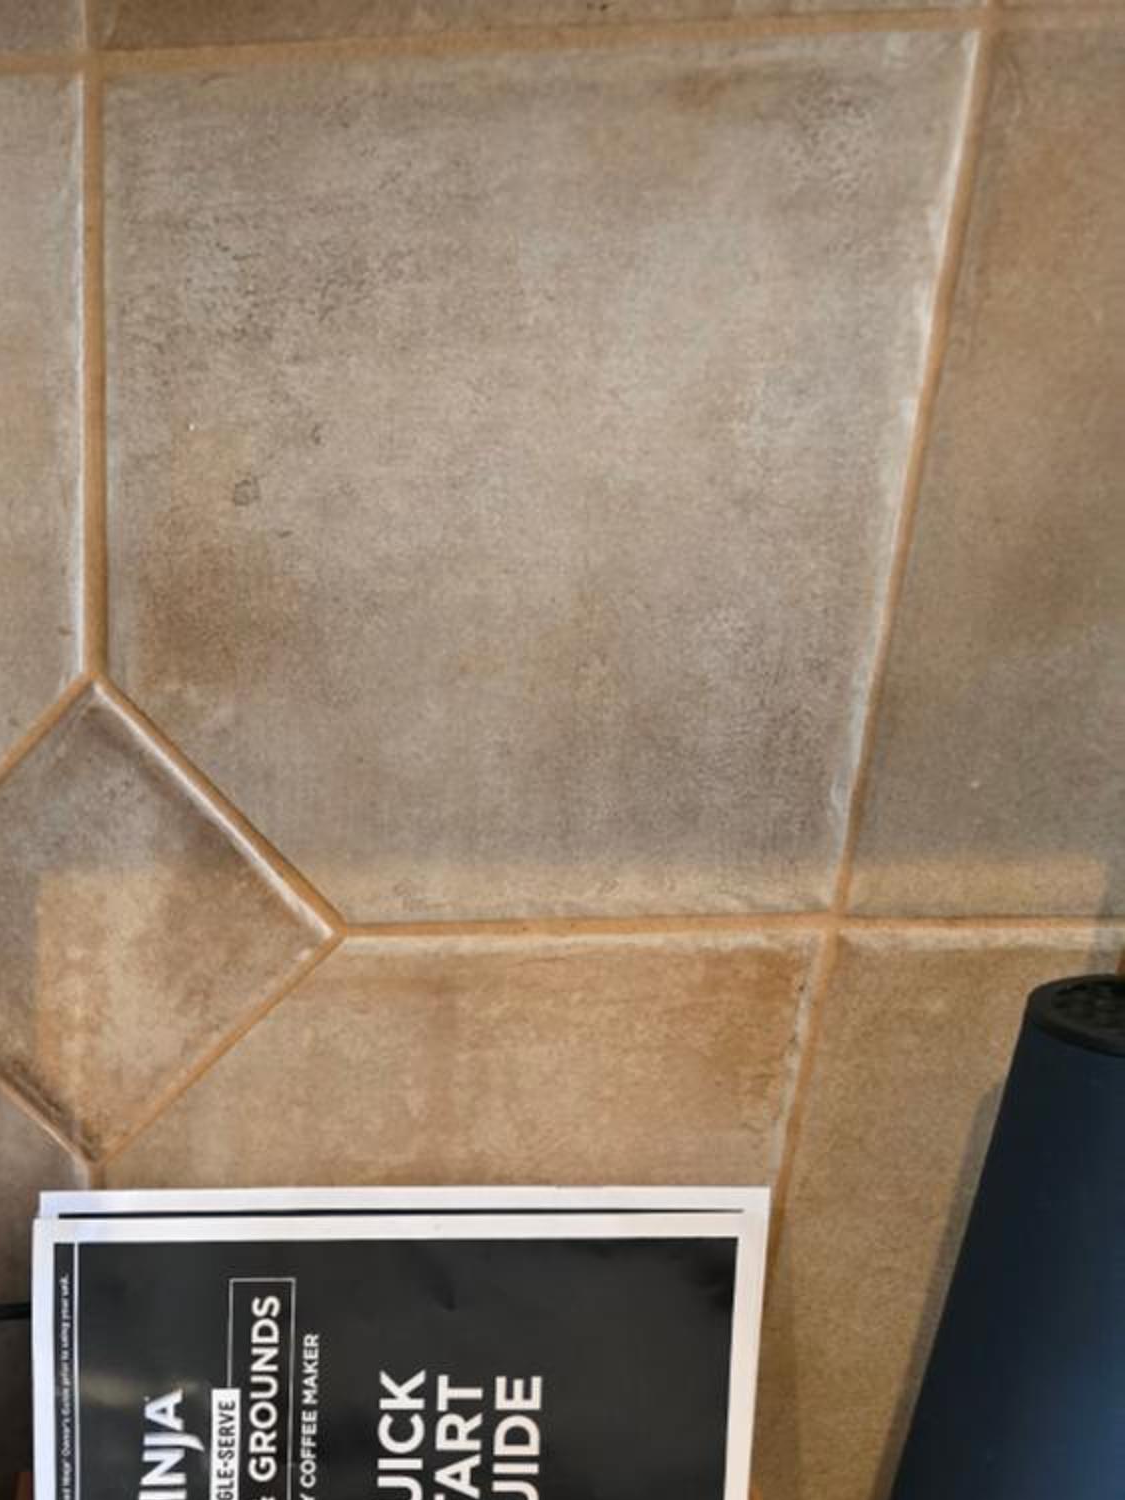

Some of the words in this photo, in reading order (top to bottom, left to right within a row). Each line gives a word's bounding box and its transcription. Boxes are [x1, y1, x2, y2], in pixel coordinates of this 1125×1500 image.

[248, 1295, 281, 1482] GROUNDS
[300, 1334, 320, 1404] MAKER
[300, 1410, 318, 1488] COFFEE
